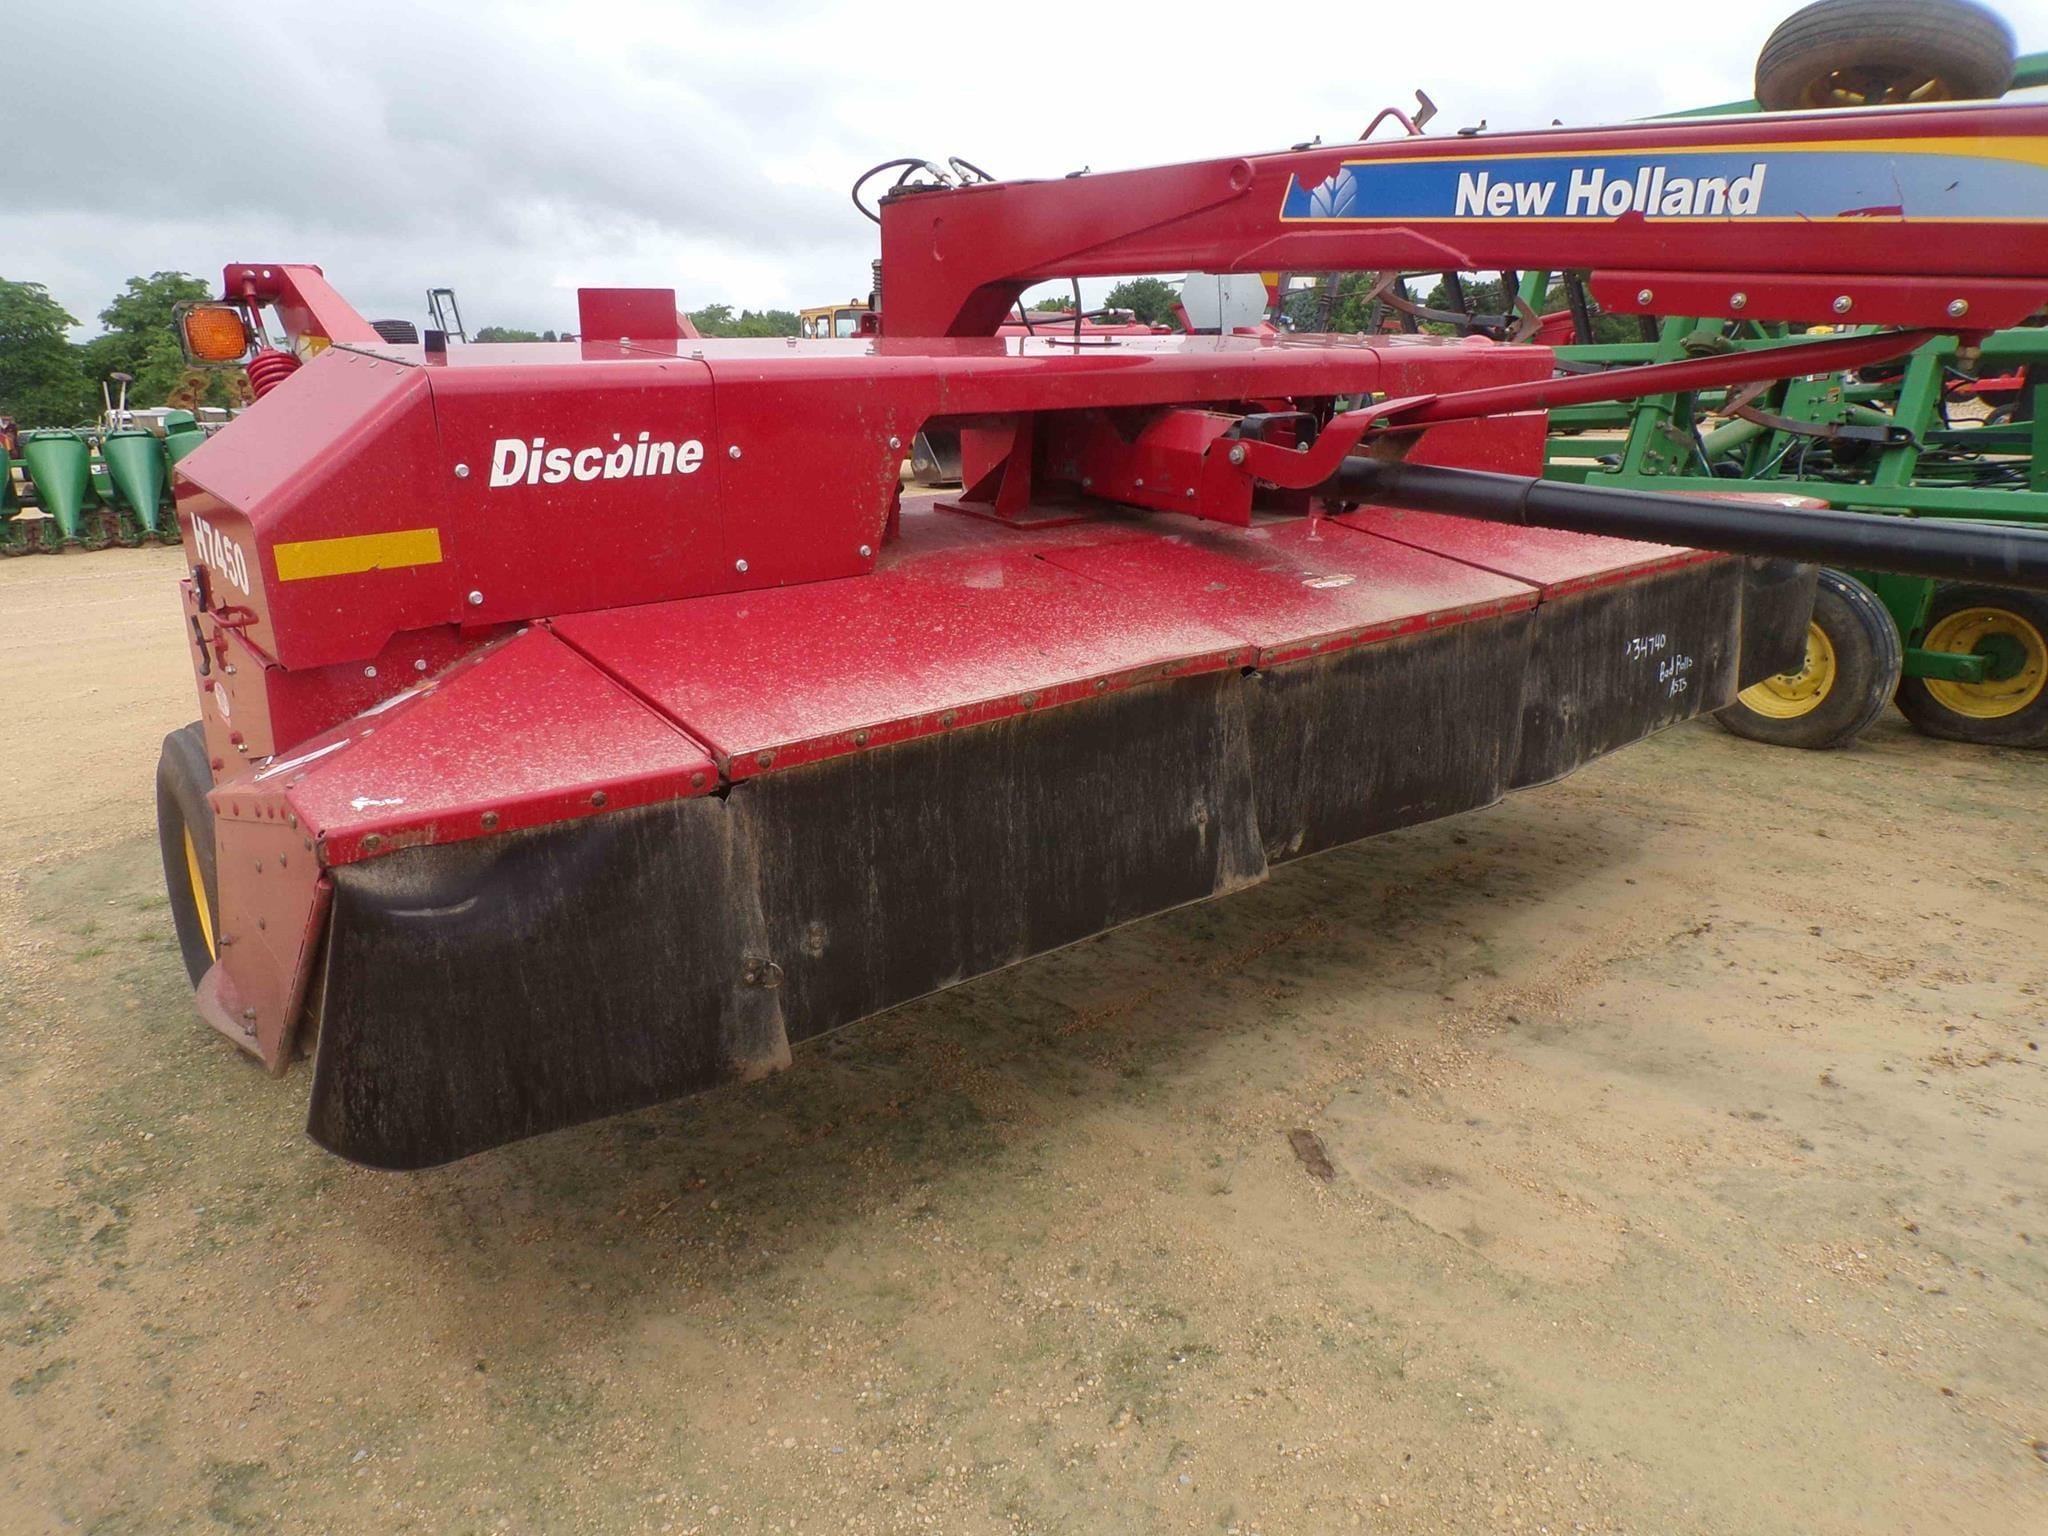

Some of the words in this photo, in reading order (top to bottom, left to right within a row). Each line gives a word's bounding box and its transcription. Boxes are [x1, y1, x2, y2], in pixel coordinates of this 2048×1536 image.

[1454, 172, 1556, 216] New
[1565, 163, 1767, 216] Holland
[488, 431, 704, 487] Discbine
[190, 511, 250, 596] H7450
